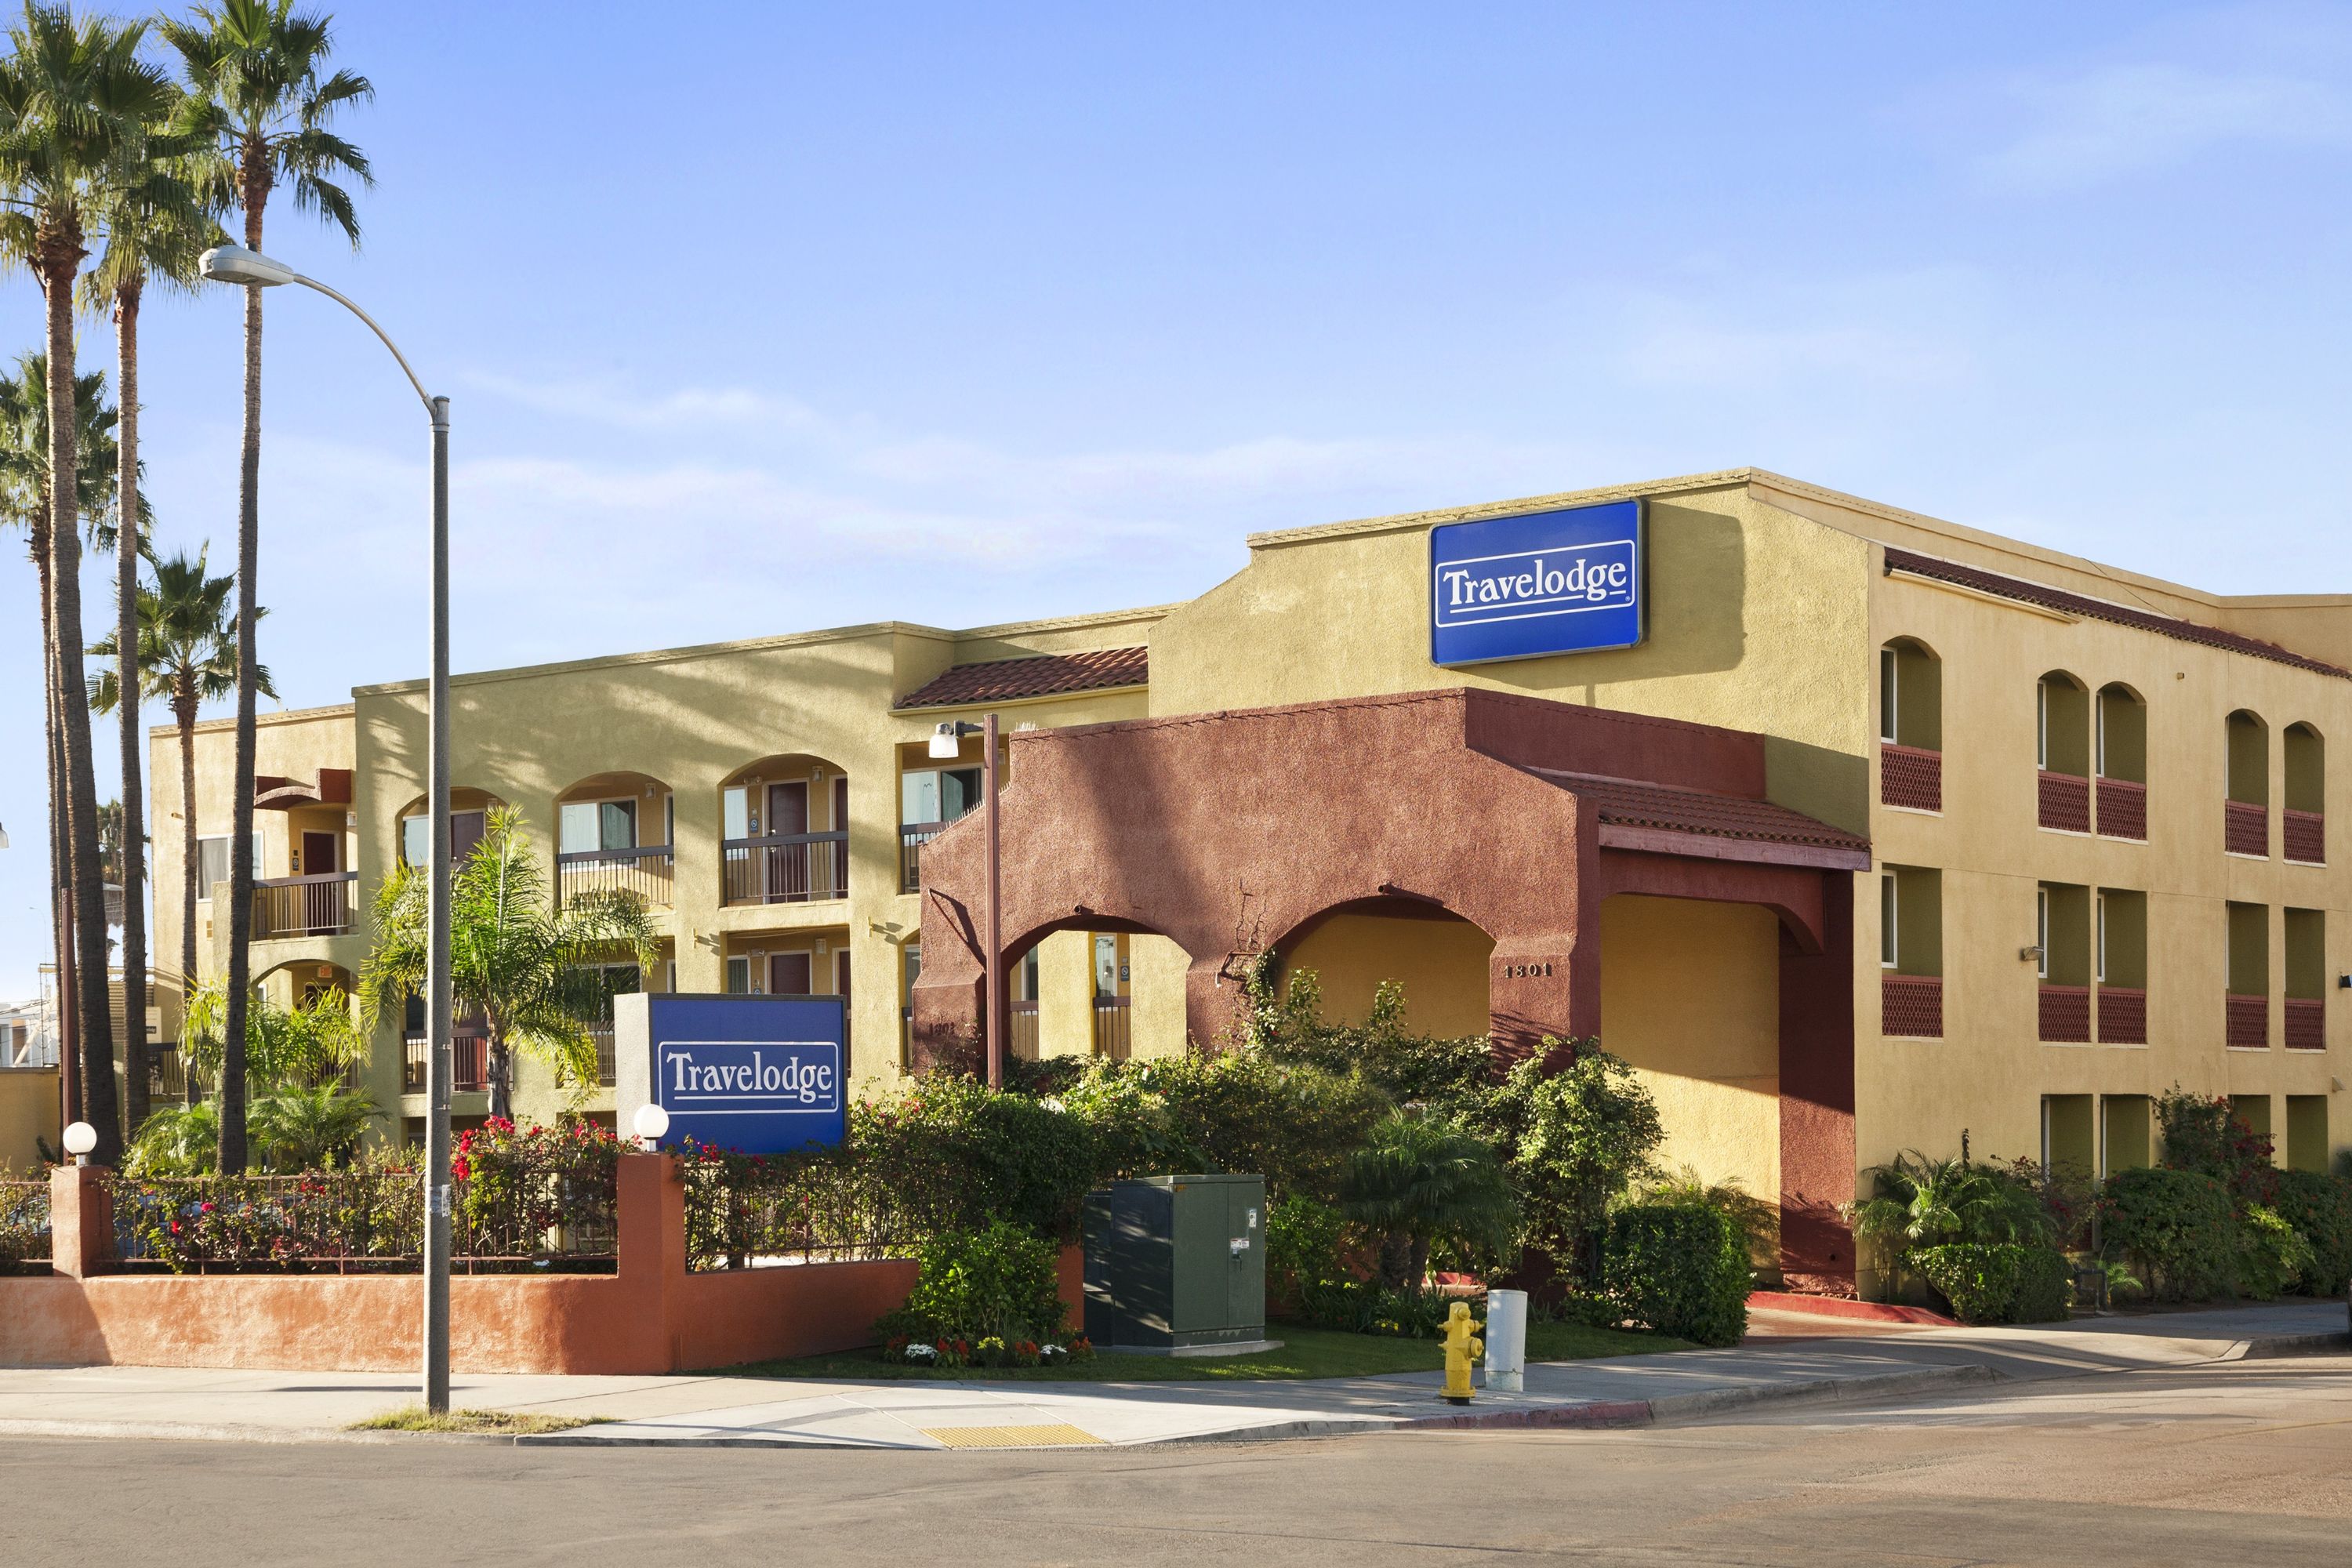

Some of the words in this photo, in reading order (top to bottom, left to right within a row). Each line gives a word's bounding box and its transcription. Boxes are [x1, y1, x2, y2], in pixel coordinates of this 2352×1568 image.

[1443, 558, 1627, 602] Travelodge
[1504, 962, 1552, 979] 1801
[666, 1051, 833, 1104] Travelodge
